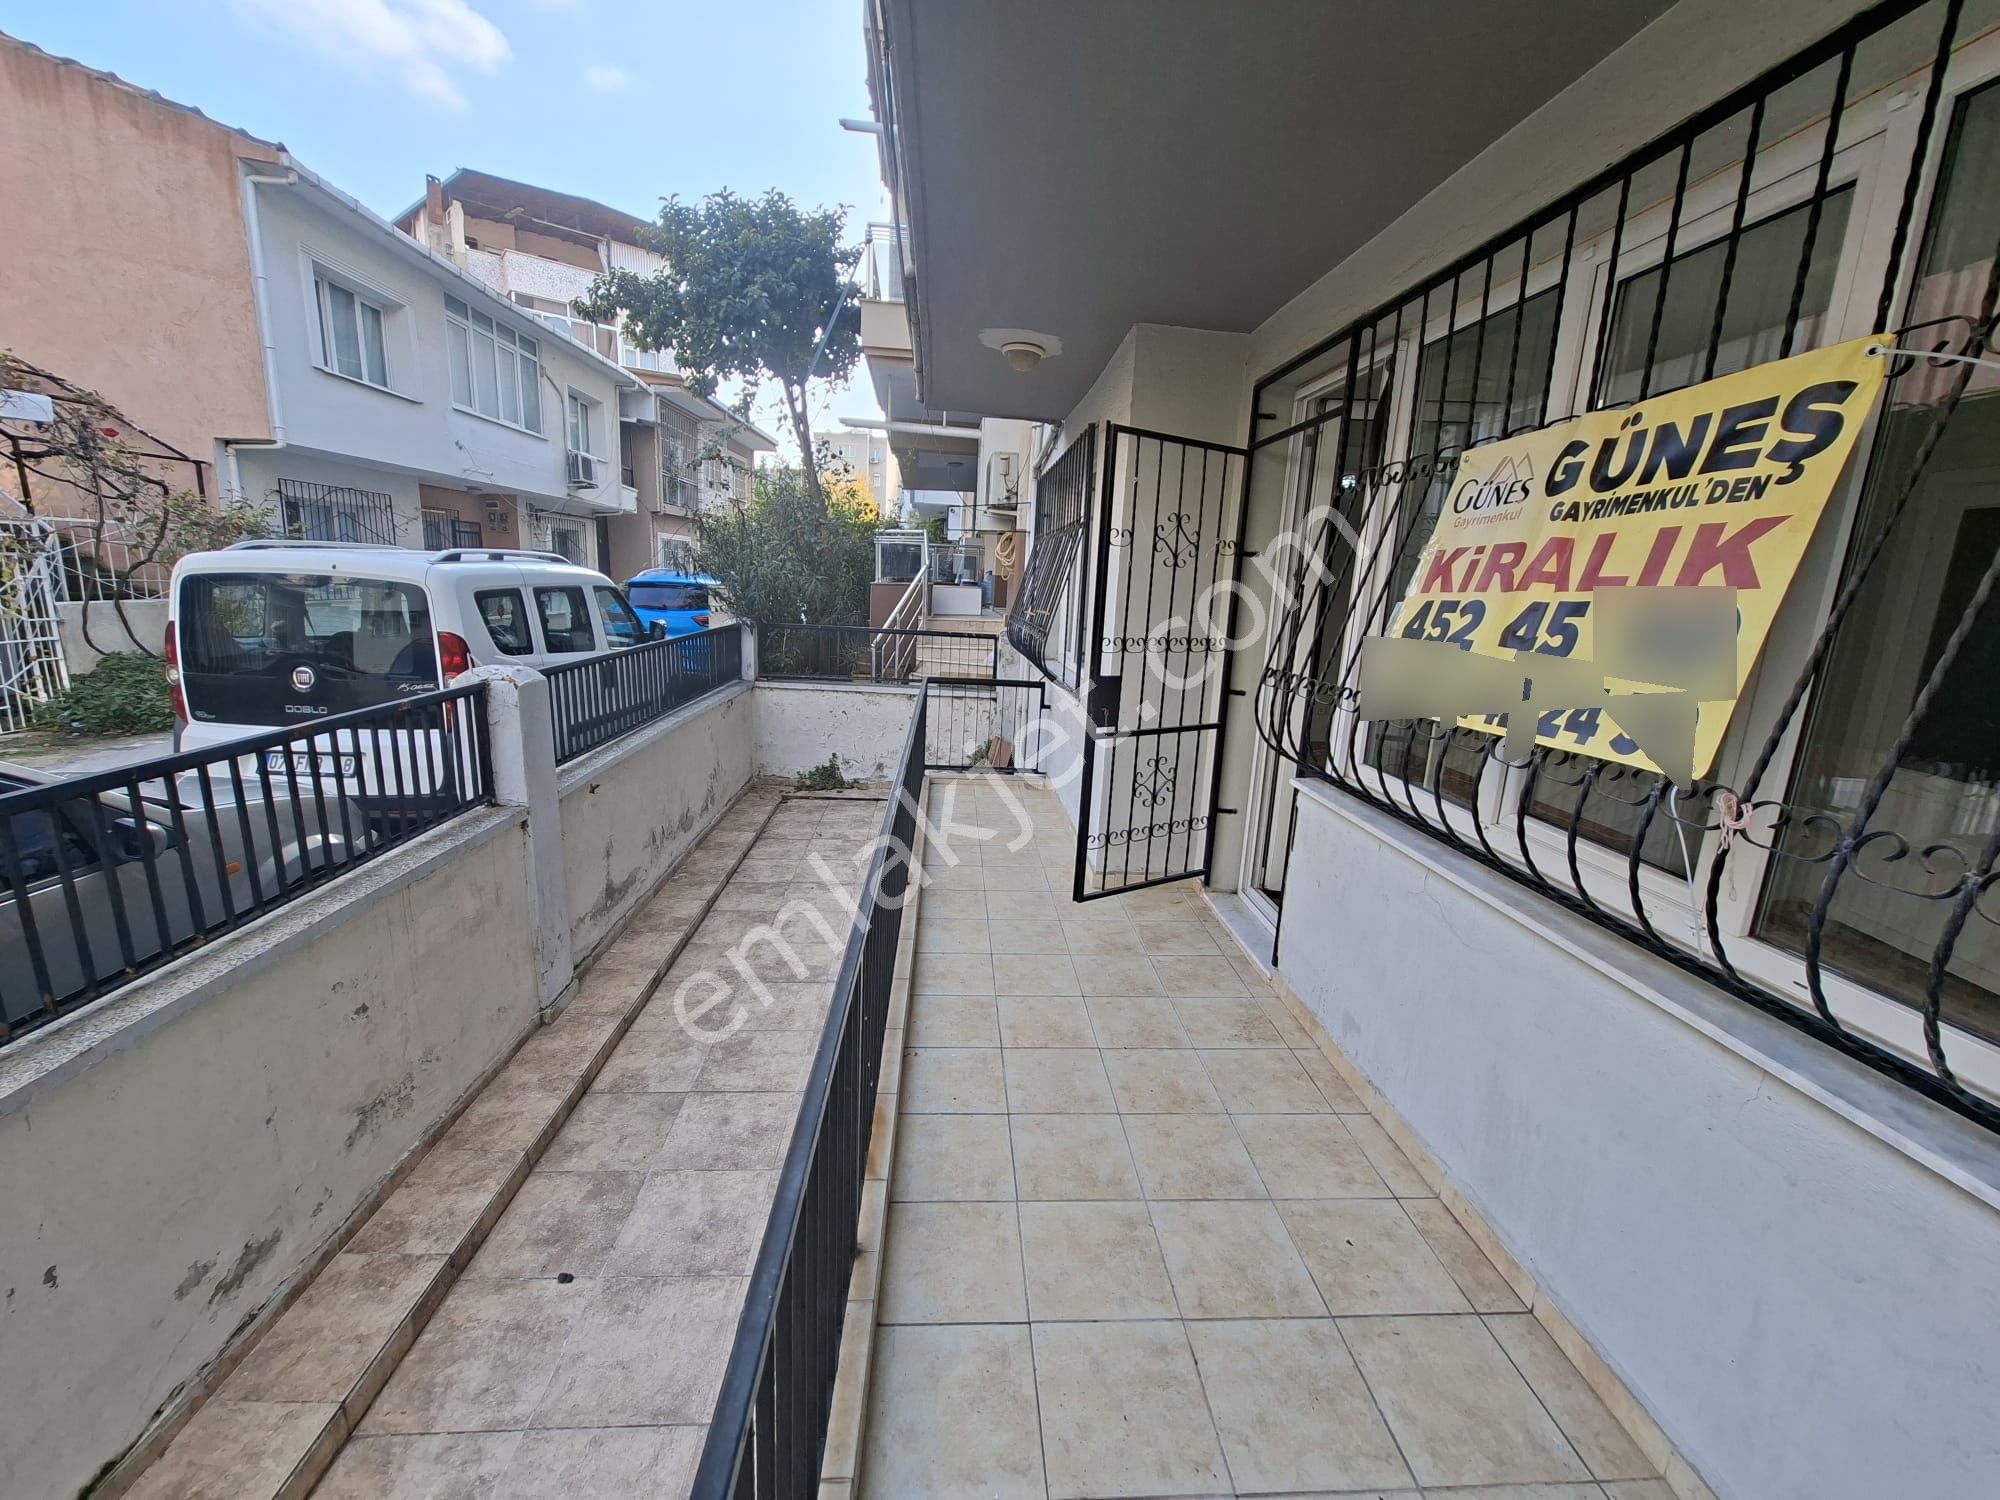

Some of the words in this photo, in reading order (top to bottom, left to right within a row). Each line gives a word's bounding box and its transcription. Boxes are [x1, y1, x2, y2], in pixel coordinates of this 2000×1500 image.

[1544, 381, 1860, 498] GÜNEŞ
[1453, 507, 1524, 531] Gayrimenkul
[1401, 600, 1486, 651] 452
[1498, 600, 1592, 657] 45
[285, 705, 328, 714] DOBLO
